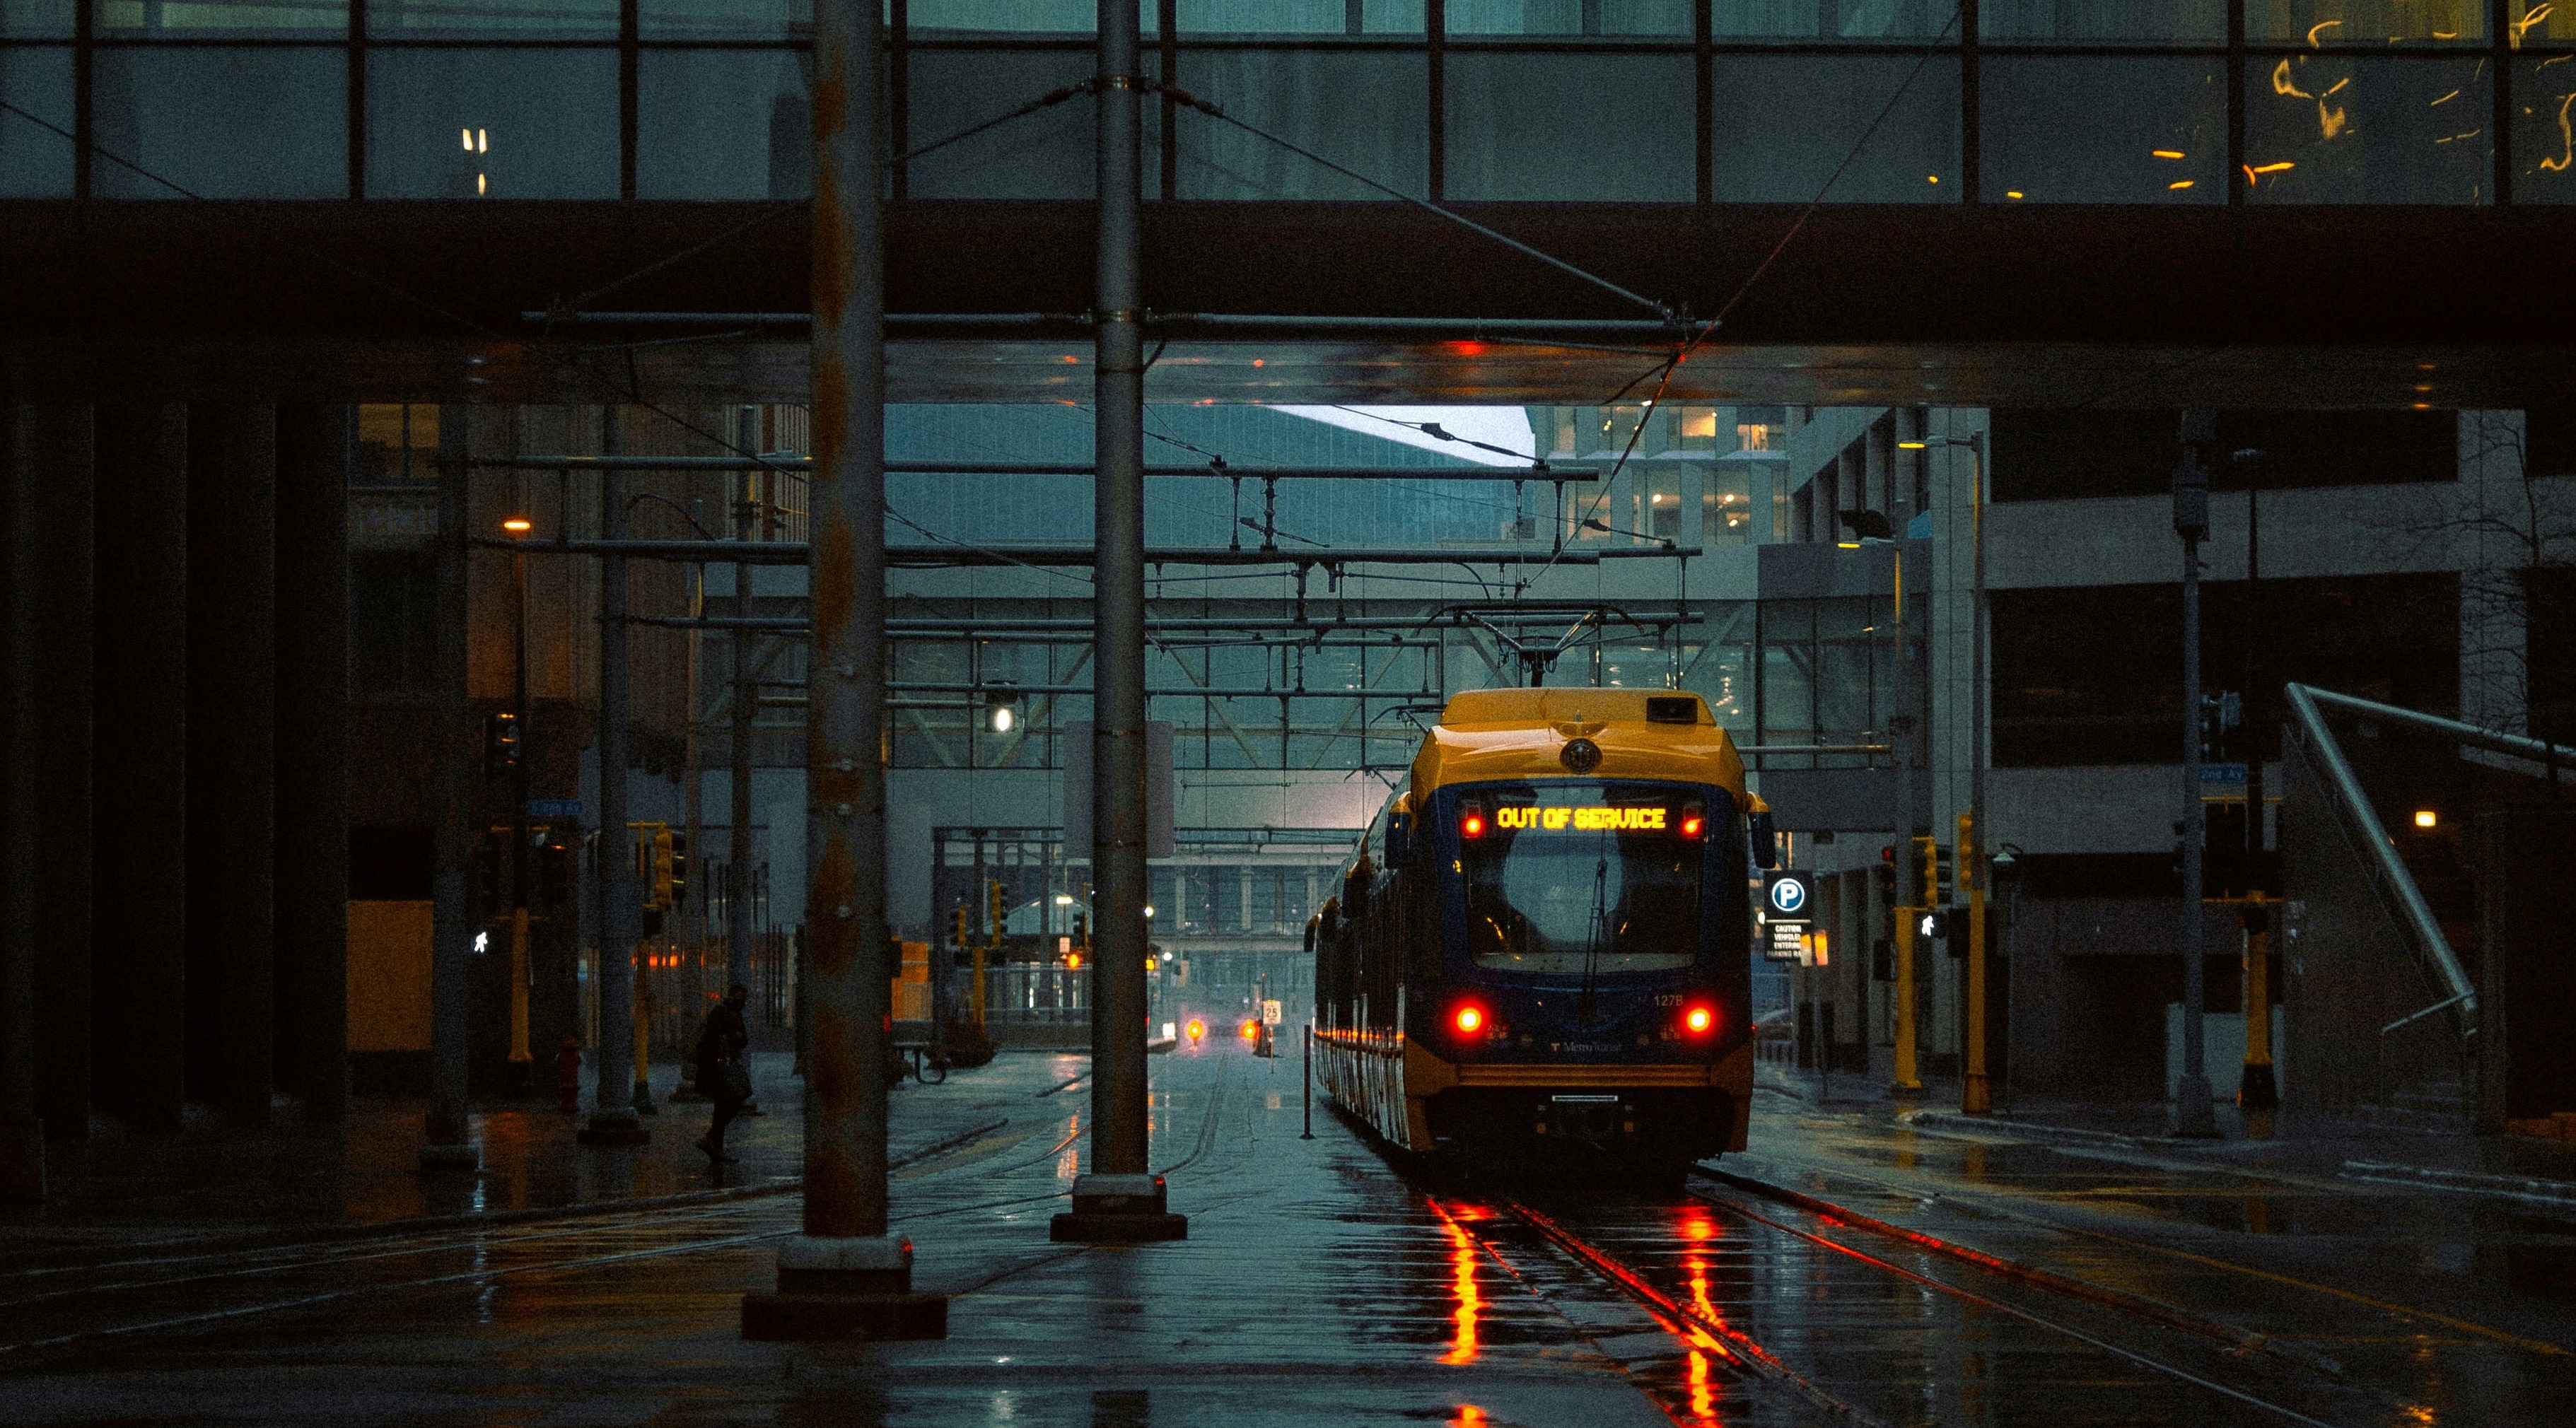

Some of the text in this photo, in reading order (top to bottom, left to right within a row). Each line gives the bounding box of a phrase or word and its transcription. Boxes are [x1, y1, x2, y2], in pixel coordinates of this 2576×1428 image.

[1498, 808, 1666, 829] OUT OF SERVICE
[1780, 883, 1799, 907] P
[1266, 1007, 1278, 1017] 25
